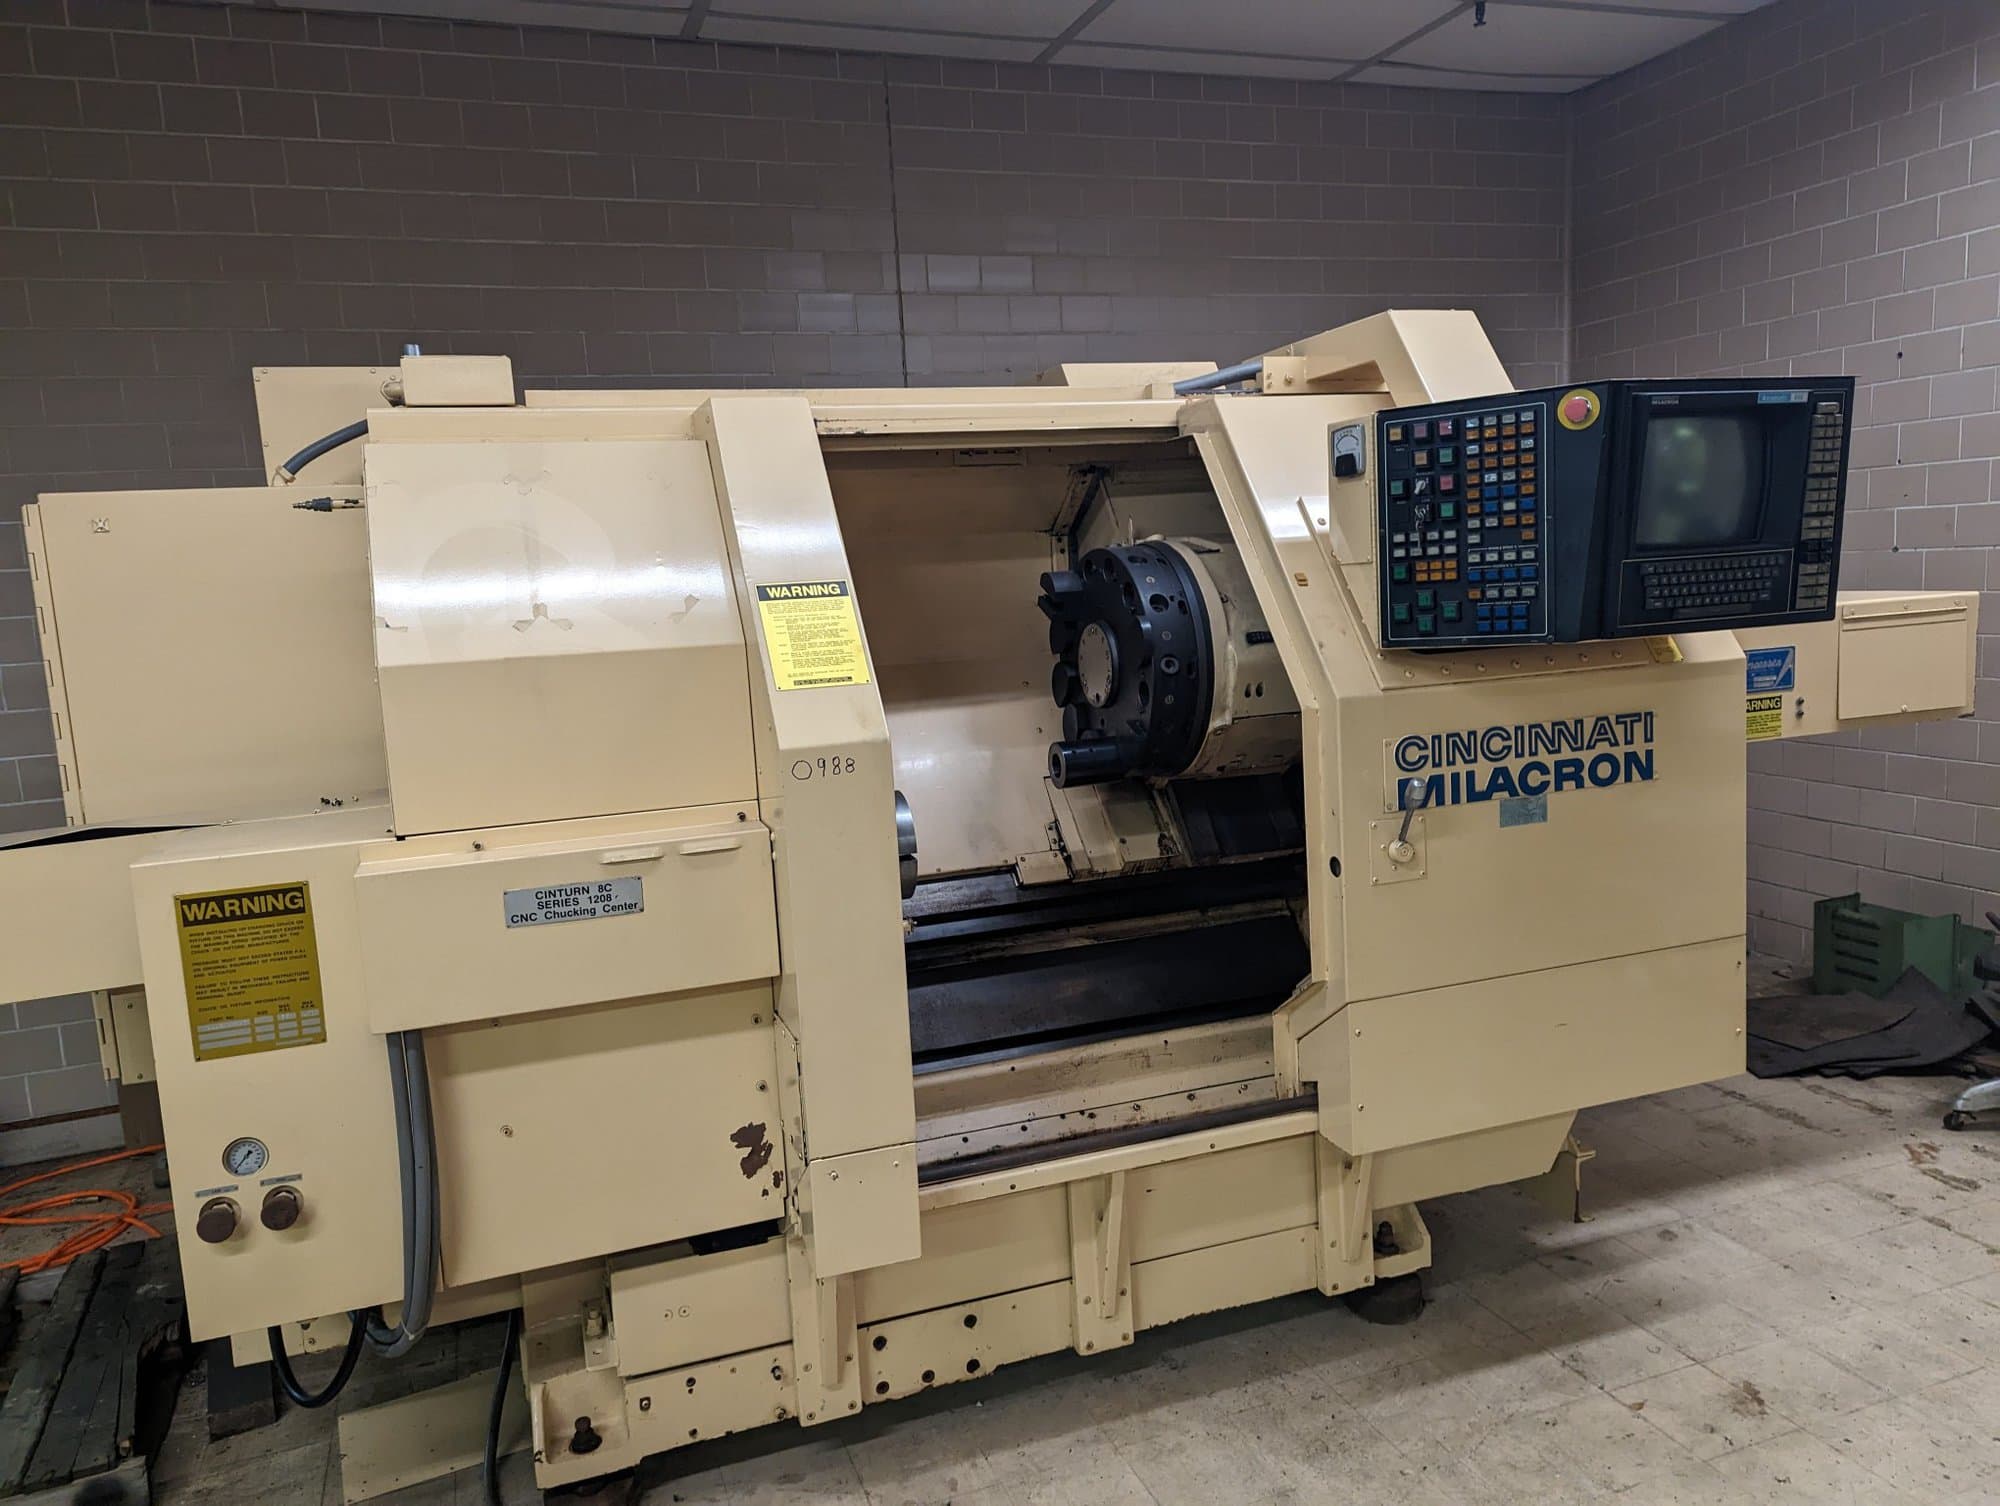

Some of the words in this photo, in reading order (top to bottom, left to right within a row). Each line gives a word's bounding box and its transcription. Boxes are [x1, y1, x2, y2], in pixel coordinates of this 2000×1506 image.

[765, 583, 842, 599] WARNING
[1747, 697, 1781, 712] ARNING
[1394, 711, 1655, 773] CINCINNATI
[1397, 748, 1655, 812] MILACRON
[535, 885, 590, 901] CINTURN
[597, 883, 613, 894] 8C
[537, 897, 580, 910] SERIES
[587, 893, 613, 905] 1208
[182, 892, 304, 922] WARNING
[510, 912, 538, 924] CNC
[544, 907, 597, 921] Chucking
[602, 901, 639, 914] Center
